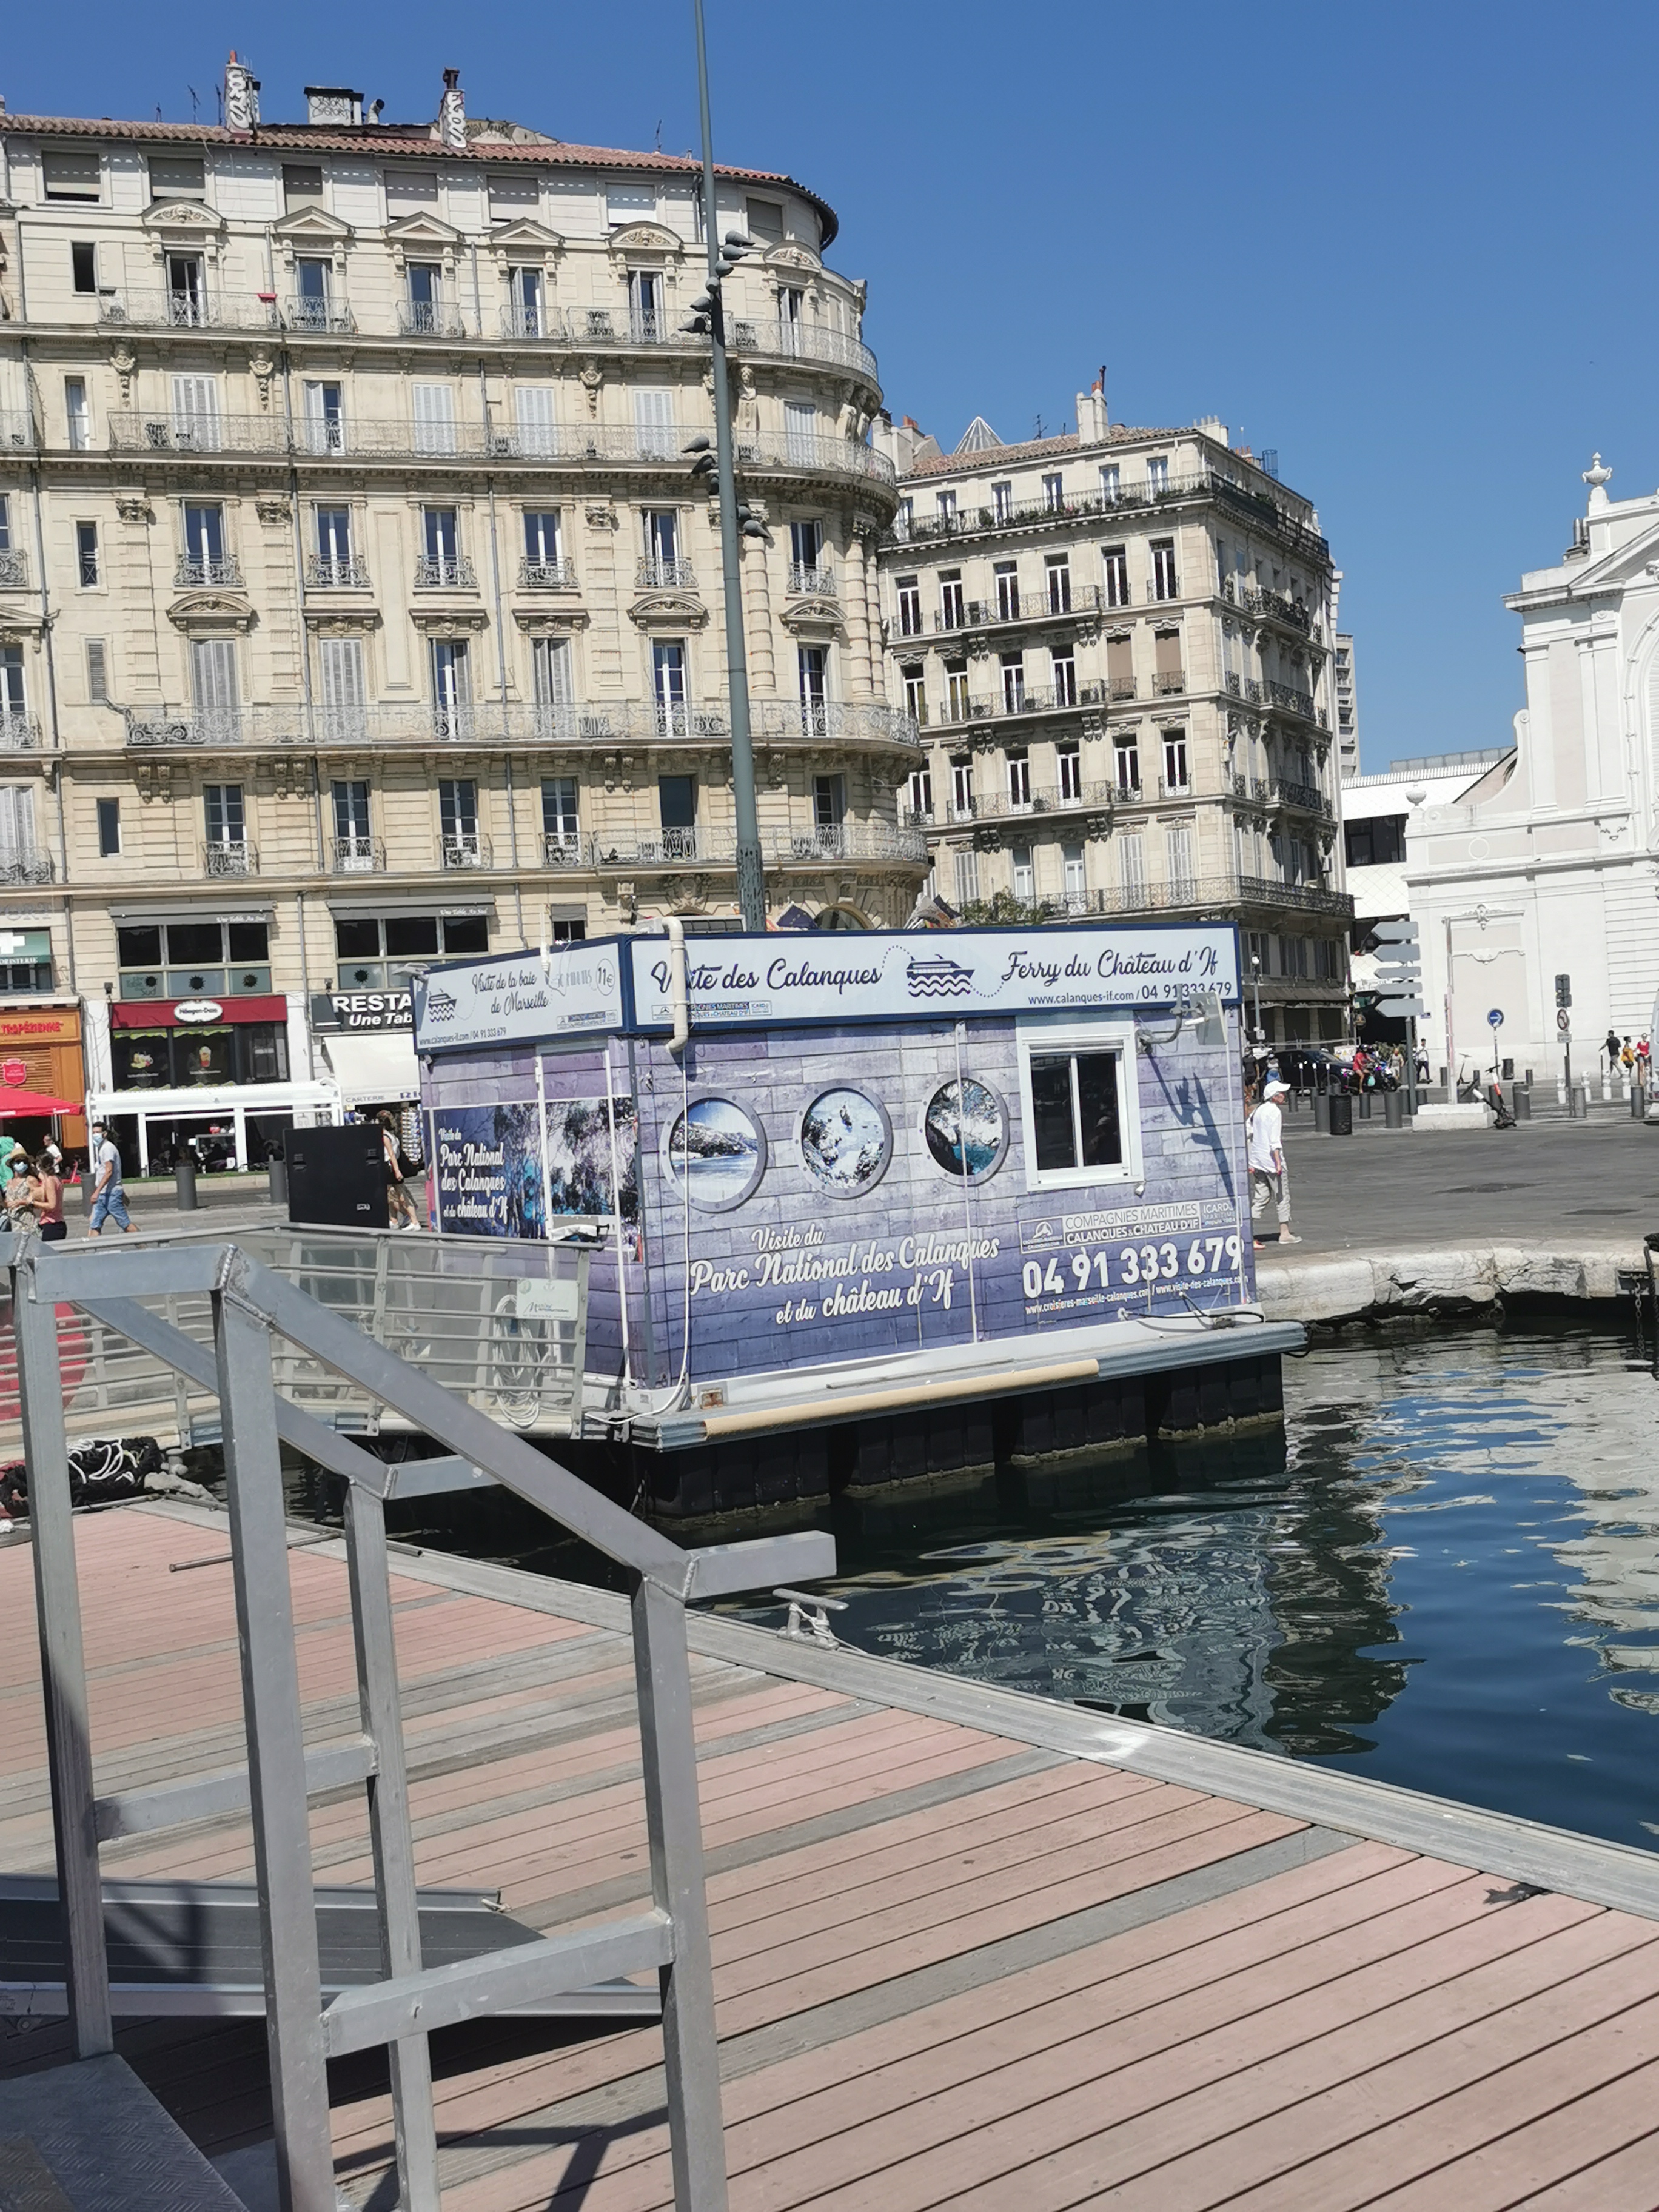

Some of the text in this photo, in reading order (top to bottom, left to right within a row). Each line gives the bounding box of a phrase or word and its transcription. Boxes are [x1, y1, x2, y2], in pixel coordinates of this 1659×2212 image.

[651, 957, 882, 995] Vite des Calanques
[1001, 946, 1219, 987] Ferry du Château d'If
[472, 973, 495, 994] Visite
[496, 973, 507, 989] de
[508, 971, 517, 988] la
[519, 970, 537, 987] baie
[1028, 990, 1134, 1004] www.calanques-if.com
[1141, 985, 1158, 999] 04
[1163, 984, 1177, 999] 91
[332, 993, 412, 1014] RESTA
[491, 990, 549, 1016] de Marseille
[349, 1012, 412, 1026] Une Tab
[440, 1142, 504, 1167] Parc National
[441, 1168, 507, 1198] des Calanques
[457, 1196, 488, 1218] château
[1065, 1203, 1198, 1230] COMPAGNIES MARITIMES
[751, 1224, 825, 1251] Visite du
[1181, 1219, 1198, 1230] D'IF
[689, 1233, 1000, 1296] Parc National des Calanques
[1022, 1235, 1244, 1298] 04 91 333 679
[776, 1269, 954, 1324] et du château d'If
